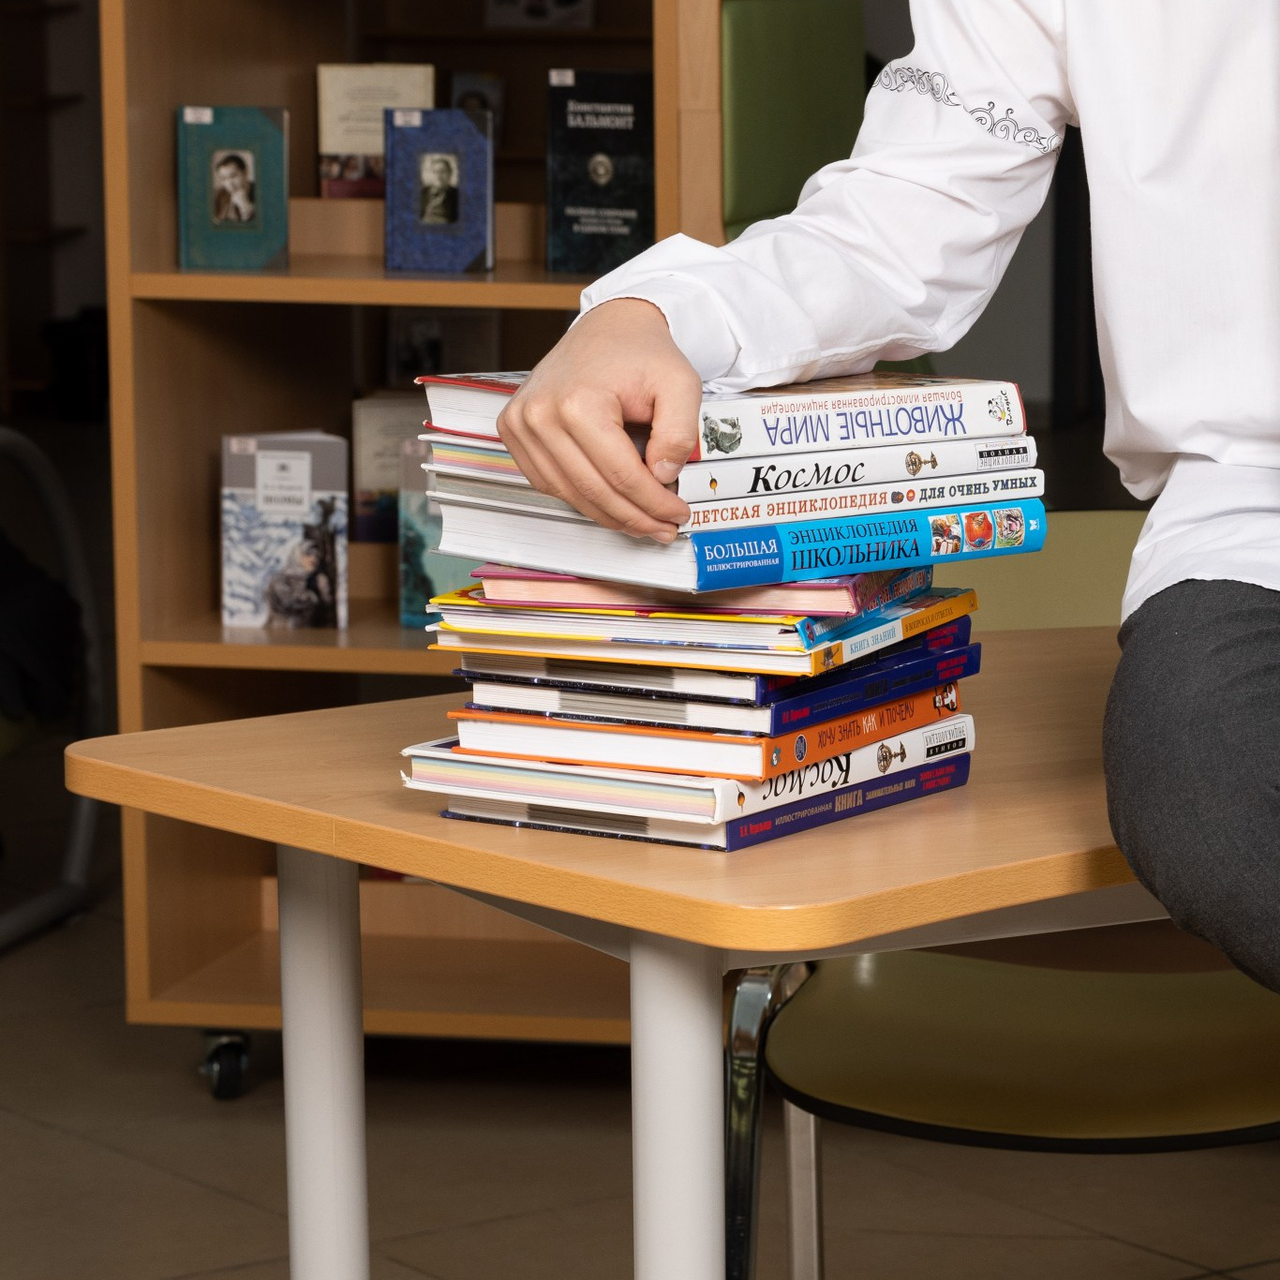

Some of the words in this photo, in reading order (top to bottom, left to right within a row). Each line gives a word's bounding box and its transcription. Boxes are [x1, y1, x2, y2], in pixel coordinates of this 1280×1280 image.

[566, 112, 635, 130] БАЛЬМОНТ
[922, 390, 963, 403] Большая
[762, 413, 831, 446] МИРА
[836, 402, 967, 441] ЖИВОТНЫЕ
[745, 462, 865, 494] Космос
[691, 504, 761, 528] ДЕТСКАЯ
[766, 491, 888, 516] ЭНЦИКЛОПЕДИЯ
[919, 487, 946, 504] ДЛЯ
[948, 482, 990, 498] ОЧЕНЬ
[992, 475, 1038, 491] УМНЫХ
[788, 518, 918, 546] ЭНЦИКЛОПЕДИЯ
[704, 538, 778, 560] БОЛЬШАЯ
[791, 538, 921, 572] ШКОЛЬНИКА
[707, 557, 780, 572] ИЛЛЮСТРИРОВАННАЯ
[849, 640, 871, 654] КНИГА
[870, 627, 897, 650] ЗНАНИЙ
[818, 726, 836, 749] ХОЧУ
[838, 719, 861, 742] ЗНАТЬ
[862, 713, 878, 735] КАК
[879, 710, 885, 727] И
[886, 700, 915, 726] ПОЧЕМУ
[762, 752, 852, 801] Космос
[835, 789, 863, 813] КНИГА
